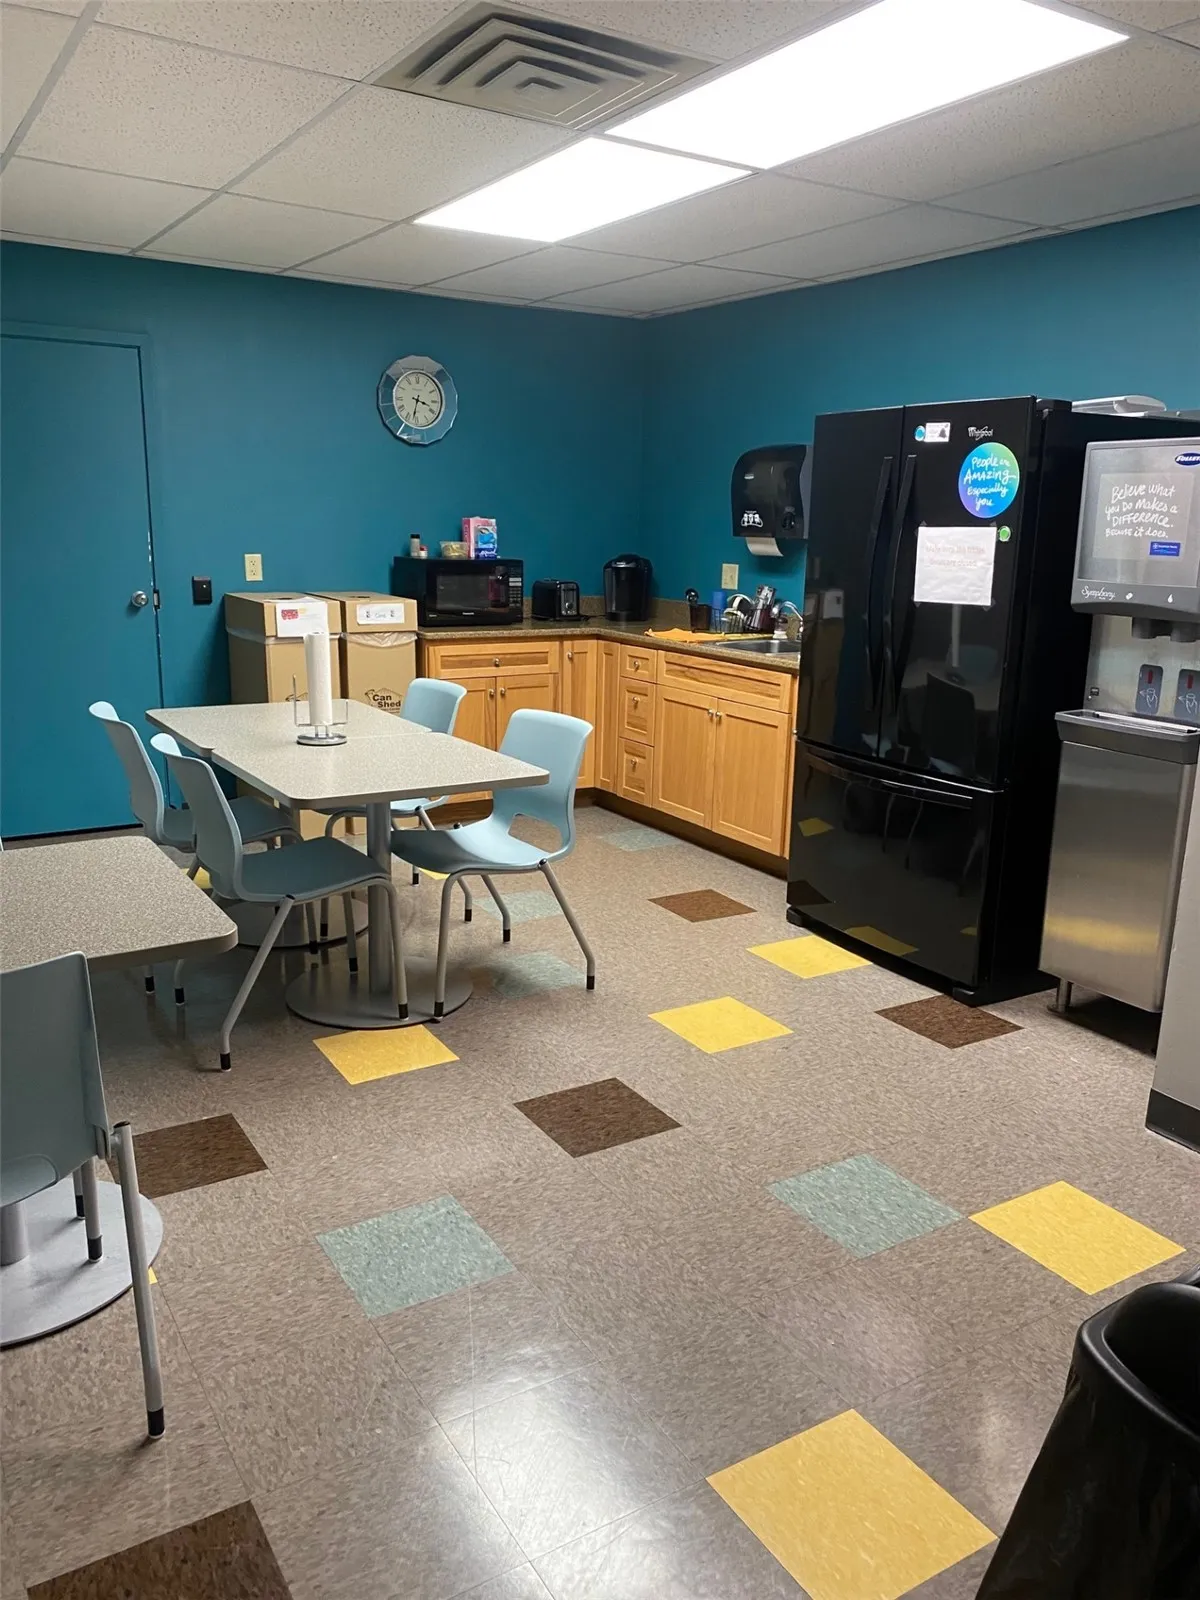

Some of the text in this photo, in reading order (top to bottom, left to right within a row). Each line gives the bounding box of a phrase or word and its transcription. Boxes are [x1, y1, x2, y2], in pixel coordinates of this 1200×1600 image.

[971, 453, 998, 470] People
[967, 483, 1009, 498] Especially
[1111, 483, 1147, 504] Believe
[1105, 504, 1120, 521] you
[1169, 504, 1178, 514] a
[1133, 526, 1145, 537] it
[1081, 585, 1116, 601] Symphony
[372, 694, 392, 702] Can
[377, 700, 401, 708] Shed
